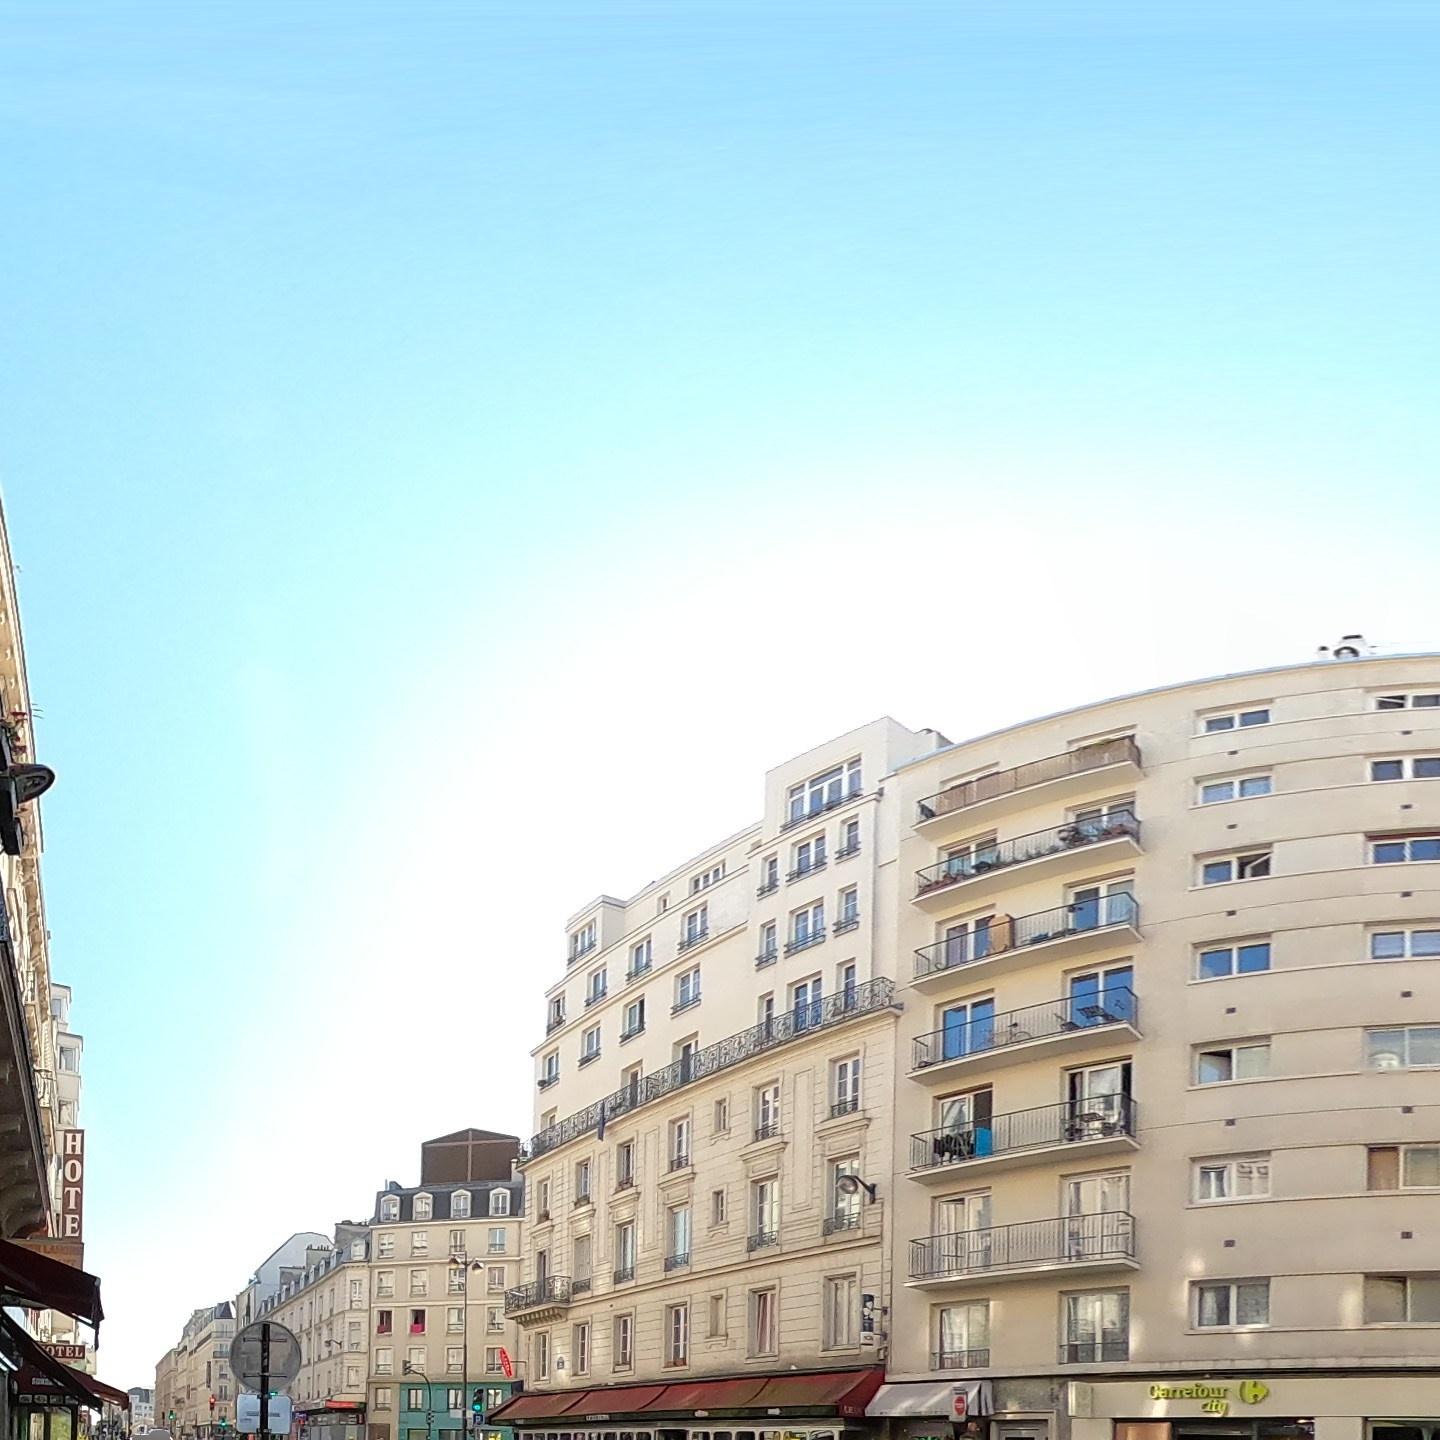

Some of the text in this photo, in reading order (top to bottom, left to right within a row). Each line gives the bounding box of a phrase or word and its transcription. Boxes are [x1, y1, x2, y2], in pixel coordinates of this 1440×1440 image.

[64, 1132, 82, 1238] HOTE
[44, 1346, 83, 1358] OTEL
[1150, 1383, 1229, 1400] Carrefour
